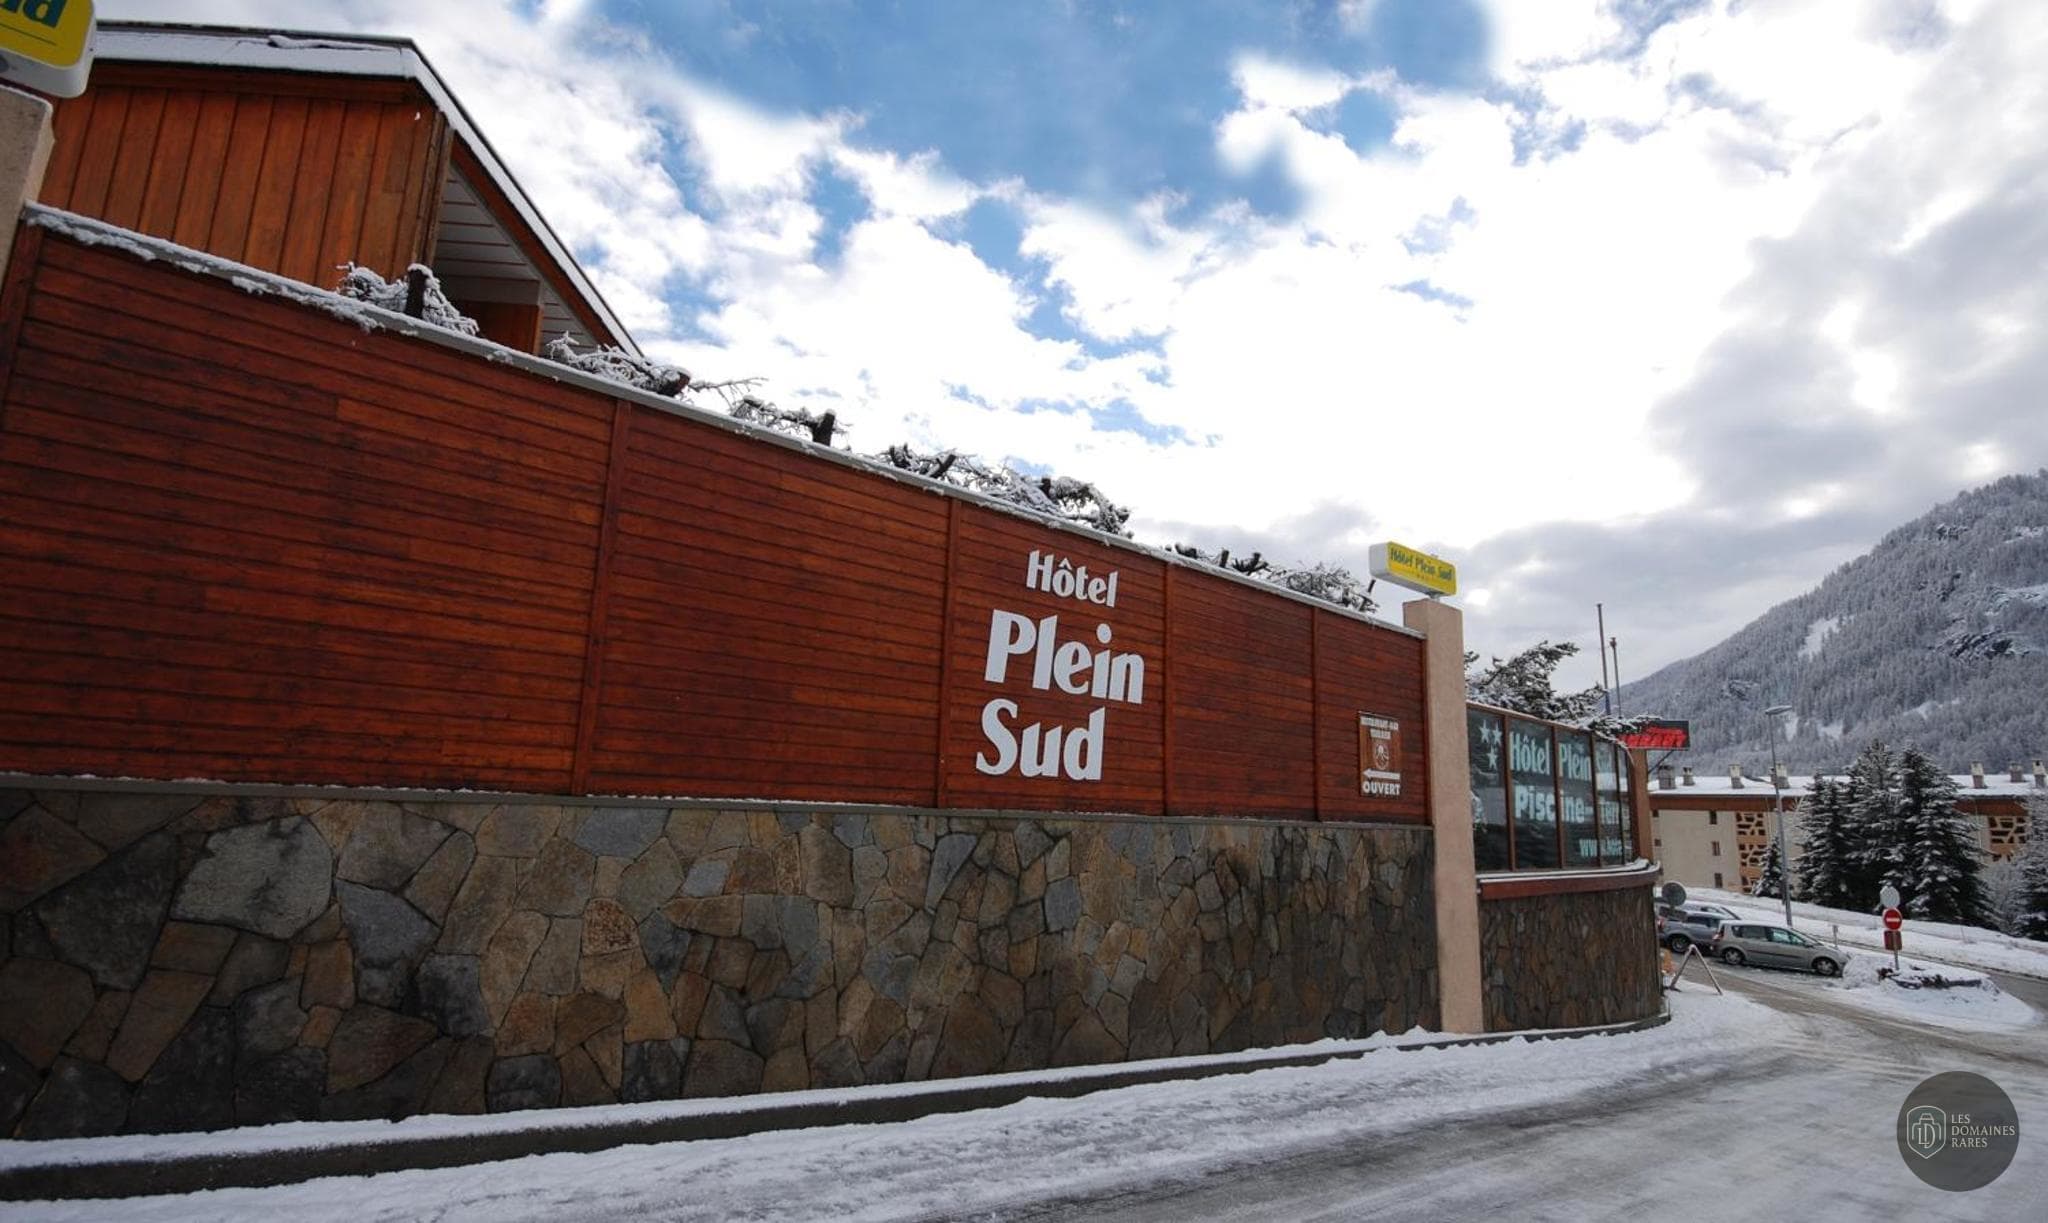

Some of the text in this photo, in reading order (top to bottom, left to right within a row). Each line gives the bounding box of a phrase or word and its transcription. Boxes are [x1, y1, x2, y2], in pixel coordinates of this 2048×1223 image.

[1026, 550, 1118, 608] Hôtel
[1390, 546, 1413, 567] Hôtel
[1415, 556, 1436, 576] Plein
[984, 609, 1145, 704] Plein
[976, 698, 1106, 781] Sud
[1509, 731, 1550, 775] Hôtel
[1558, 742, 1592, 782] Plein
[1362, 780, 1401, 796] OUVERT
